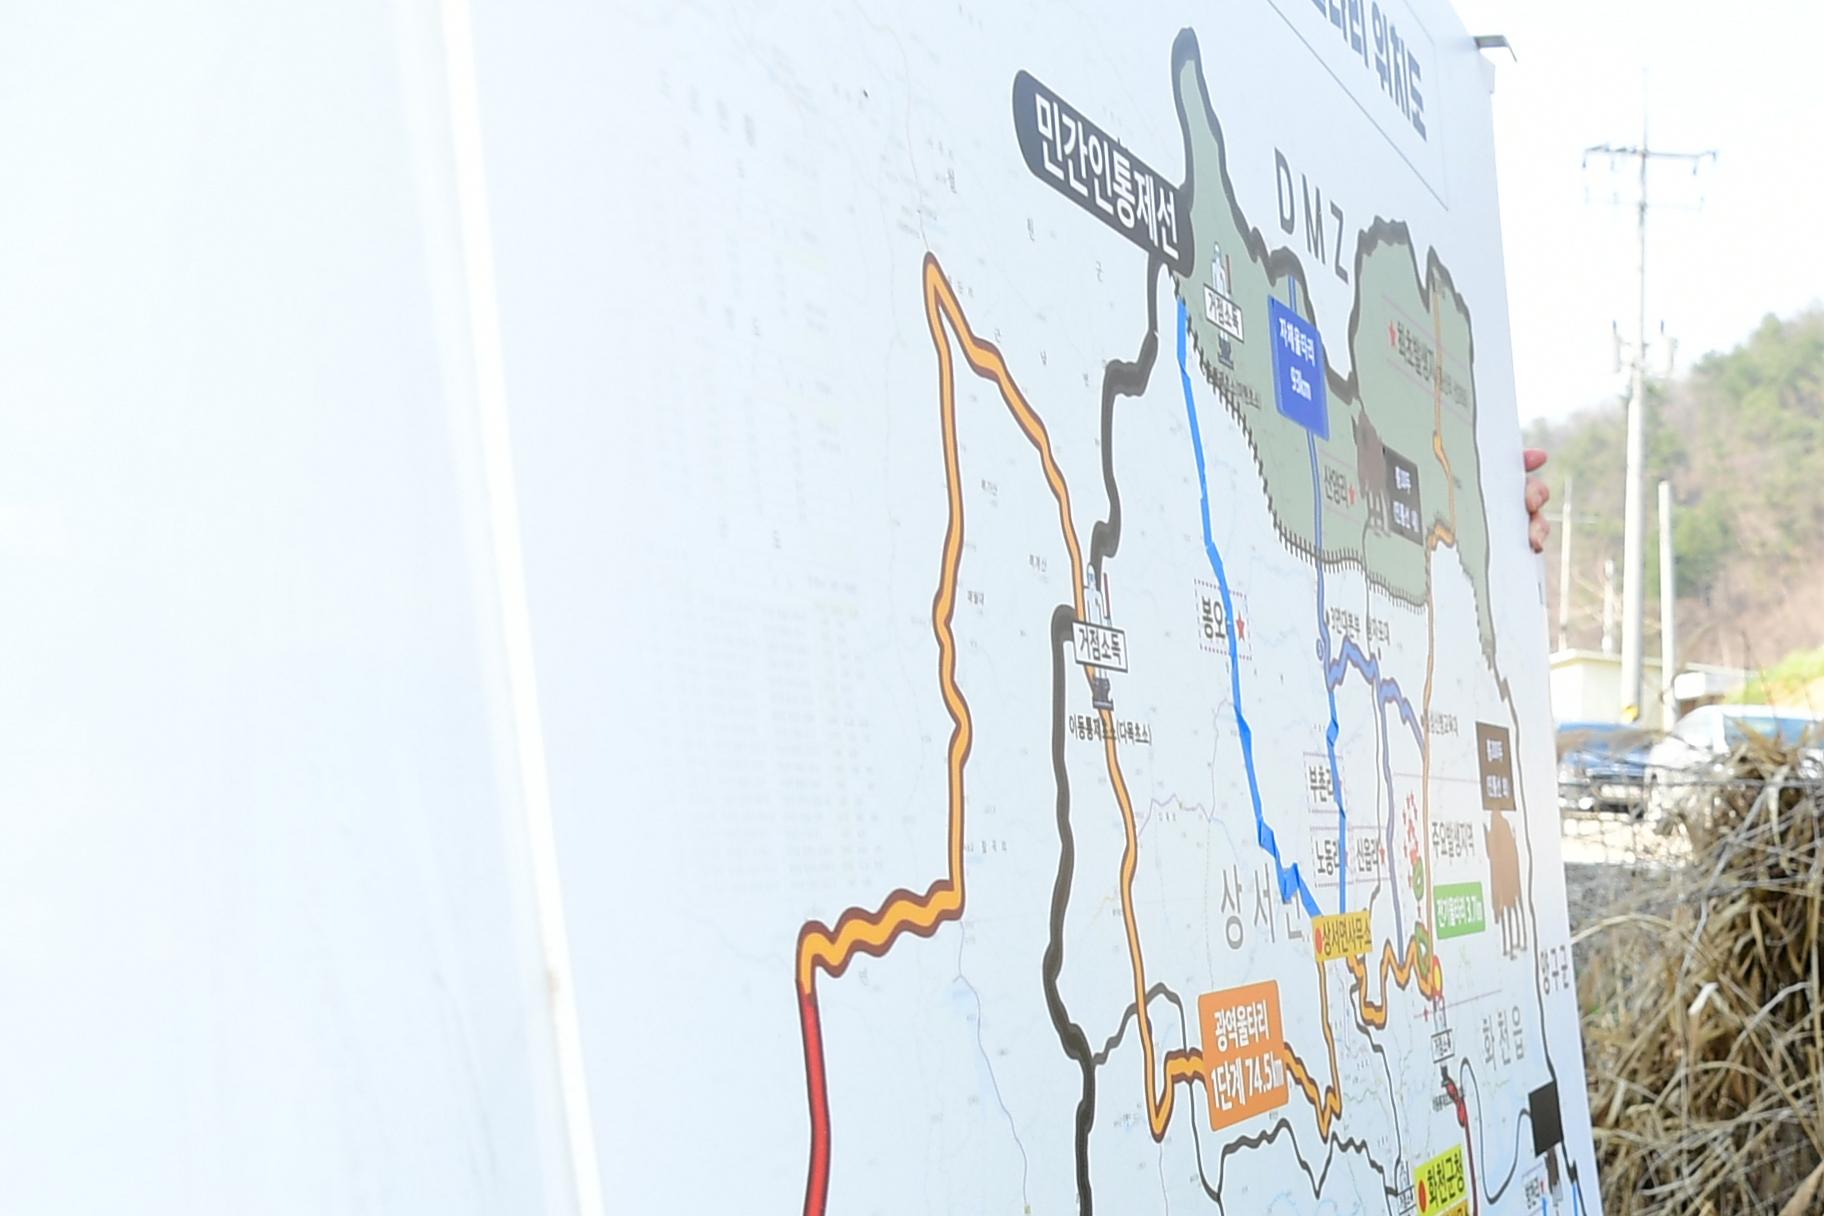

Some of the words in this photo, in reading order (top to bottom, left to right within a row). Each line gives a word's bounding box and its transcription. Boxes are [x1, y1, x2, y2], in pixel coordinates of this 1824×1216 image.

[1372, 0, 1427, 141] 위치도
[1035, 93, 1180, 260] 민간인통제선
[1208, 292, 1240, 336] 거점소독
[1201, 597, 1228, 639] 봉오
[1079, 627, 1122, 666] 거점소독
[1432, 822, 1475, 860] 주요발생지역
[1323, 916, 1372, 956] 상서면사무소
[1214, 1000, 1269, 1052] 광역울타리
[1482, 1006, 1525, 1071] 화천읍
[1211, 1057, 1246, 1111] 1단계
[1245, 1051, 1284, 1097] 74.5km
[1428, 1150, 1465, 1207] 화천군청
